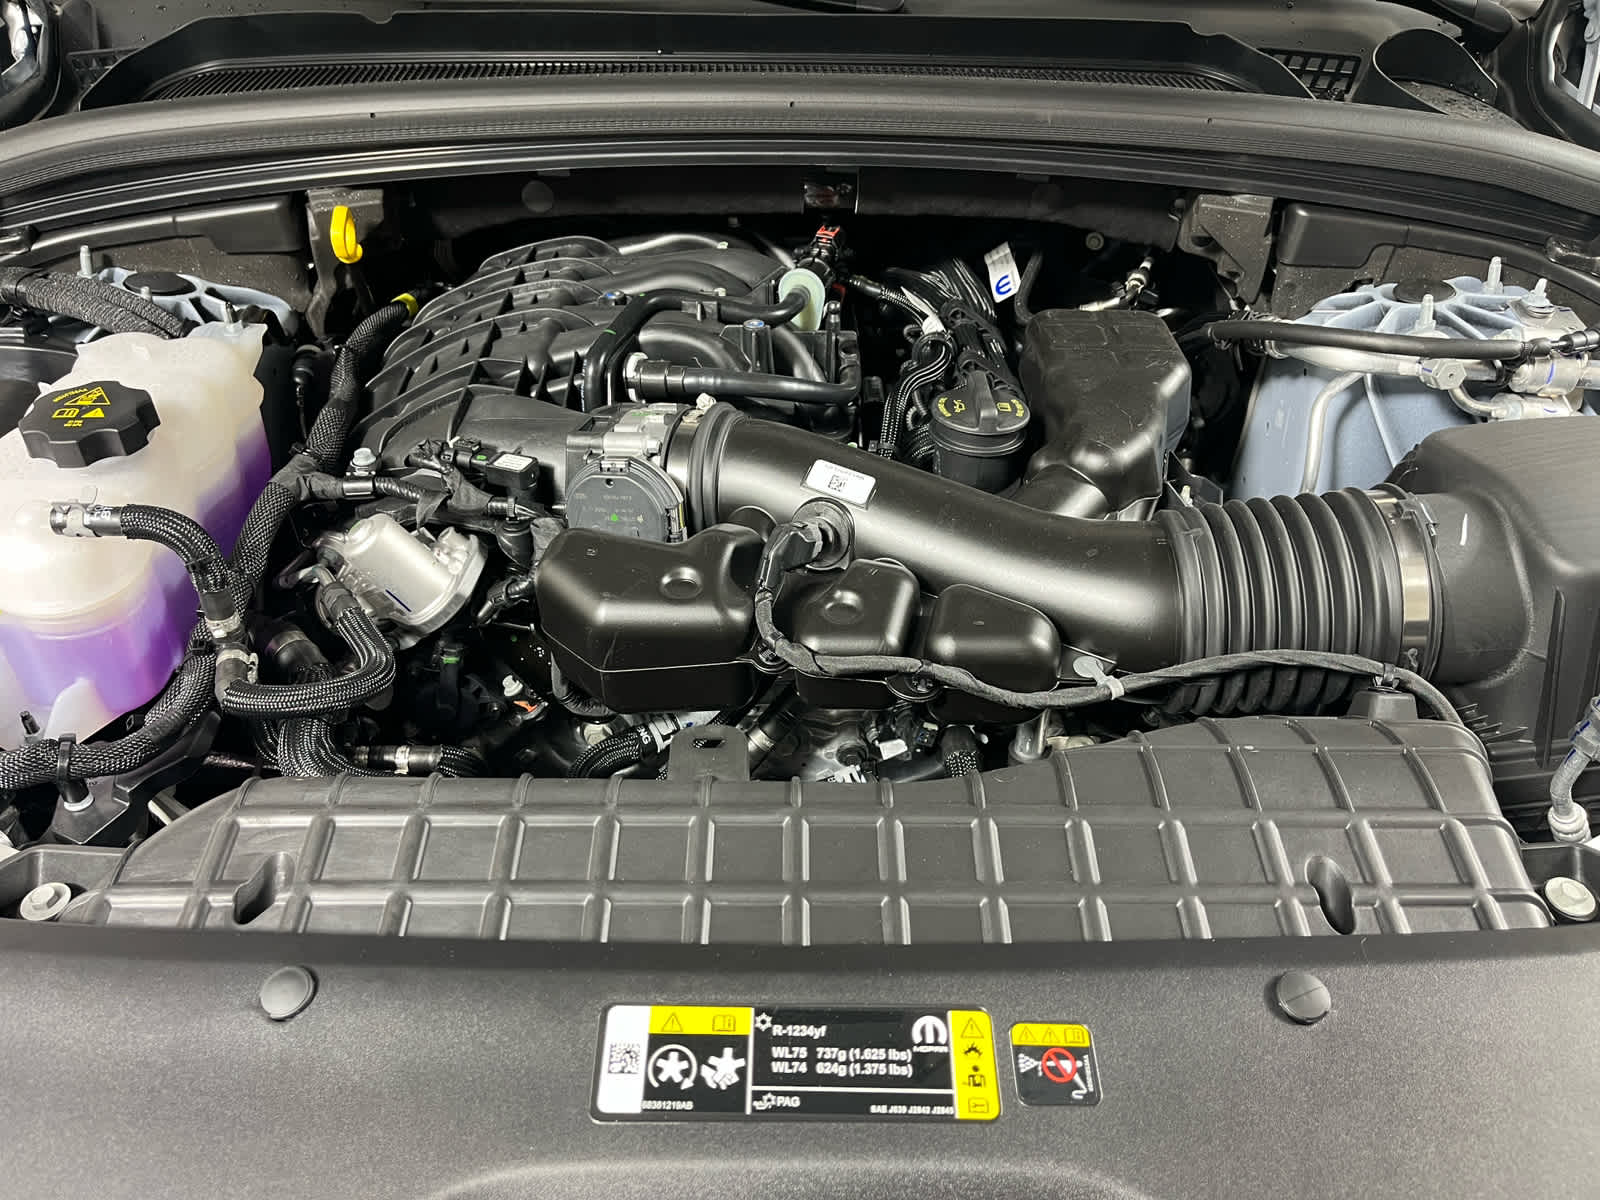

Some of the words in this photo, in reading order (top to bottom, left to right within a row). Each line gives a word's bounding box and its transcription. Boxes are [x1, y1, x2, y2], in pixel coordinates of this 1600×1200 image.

[771, 1024, 827, 1039] R-1234yf
[771, 1046, 808, 1059] WL75
[815, 1047, 847, 1062] 737g
[848, 1047, 887, 1061] (1.625
[888, 1048, 912, 1063] lbs)
[771, 1061, 808, 1074] WL74
[815, 1062, 847, 1077] 624g
[848, 1063, 887, 1077] (1.375
[888, 1063, 913, 1078] lbs)
[776, 1095, 801, 1107] PAG
